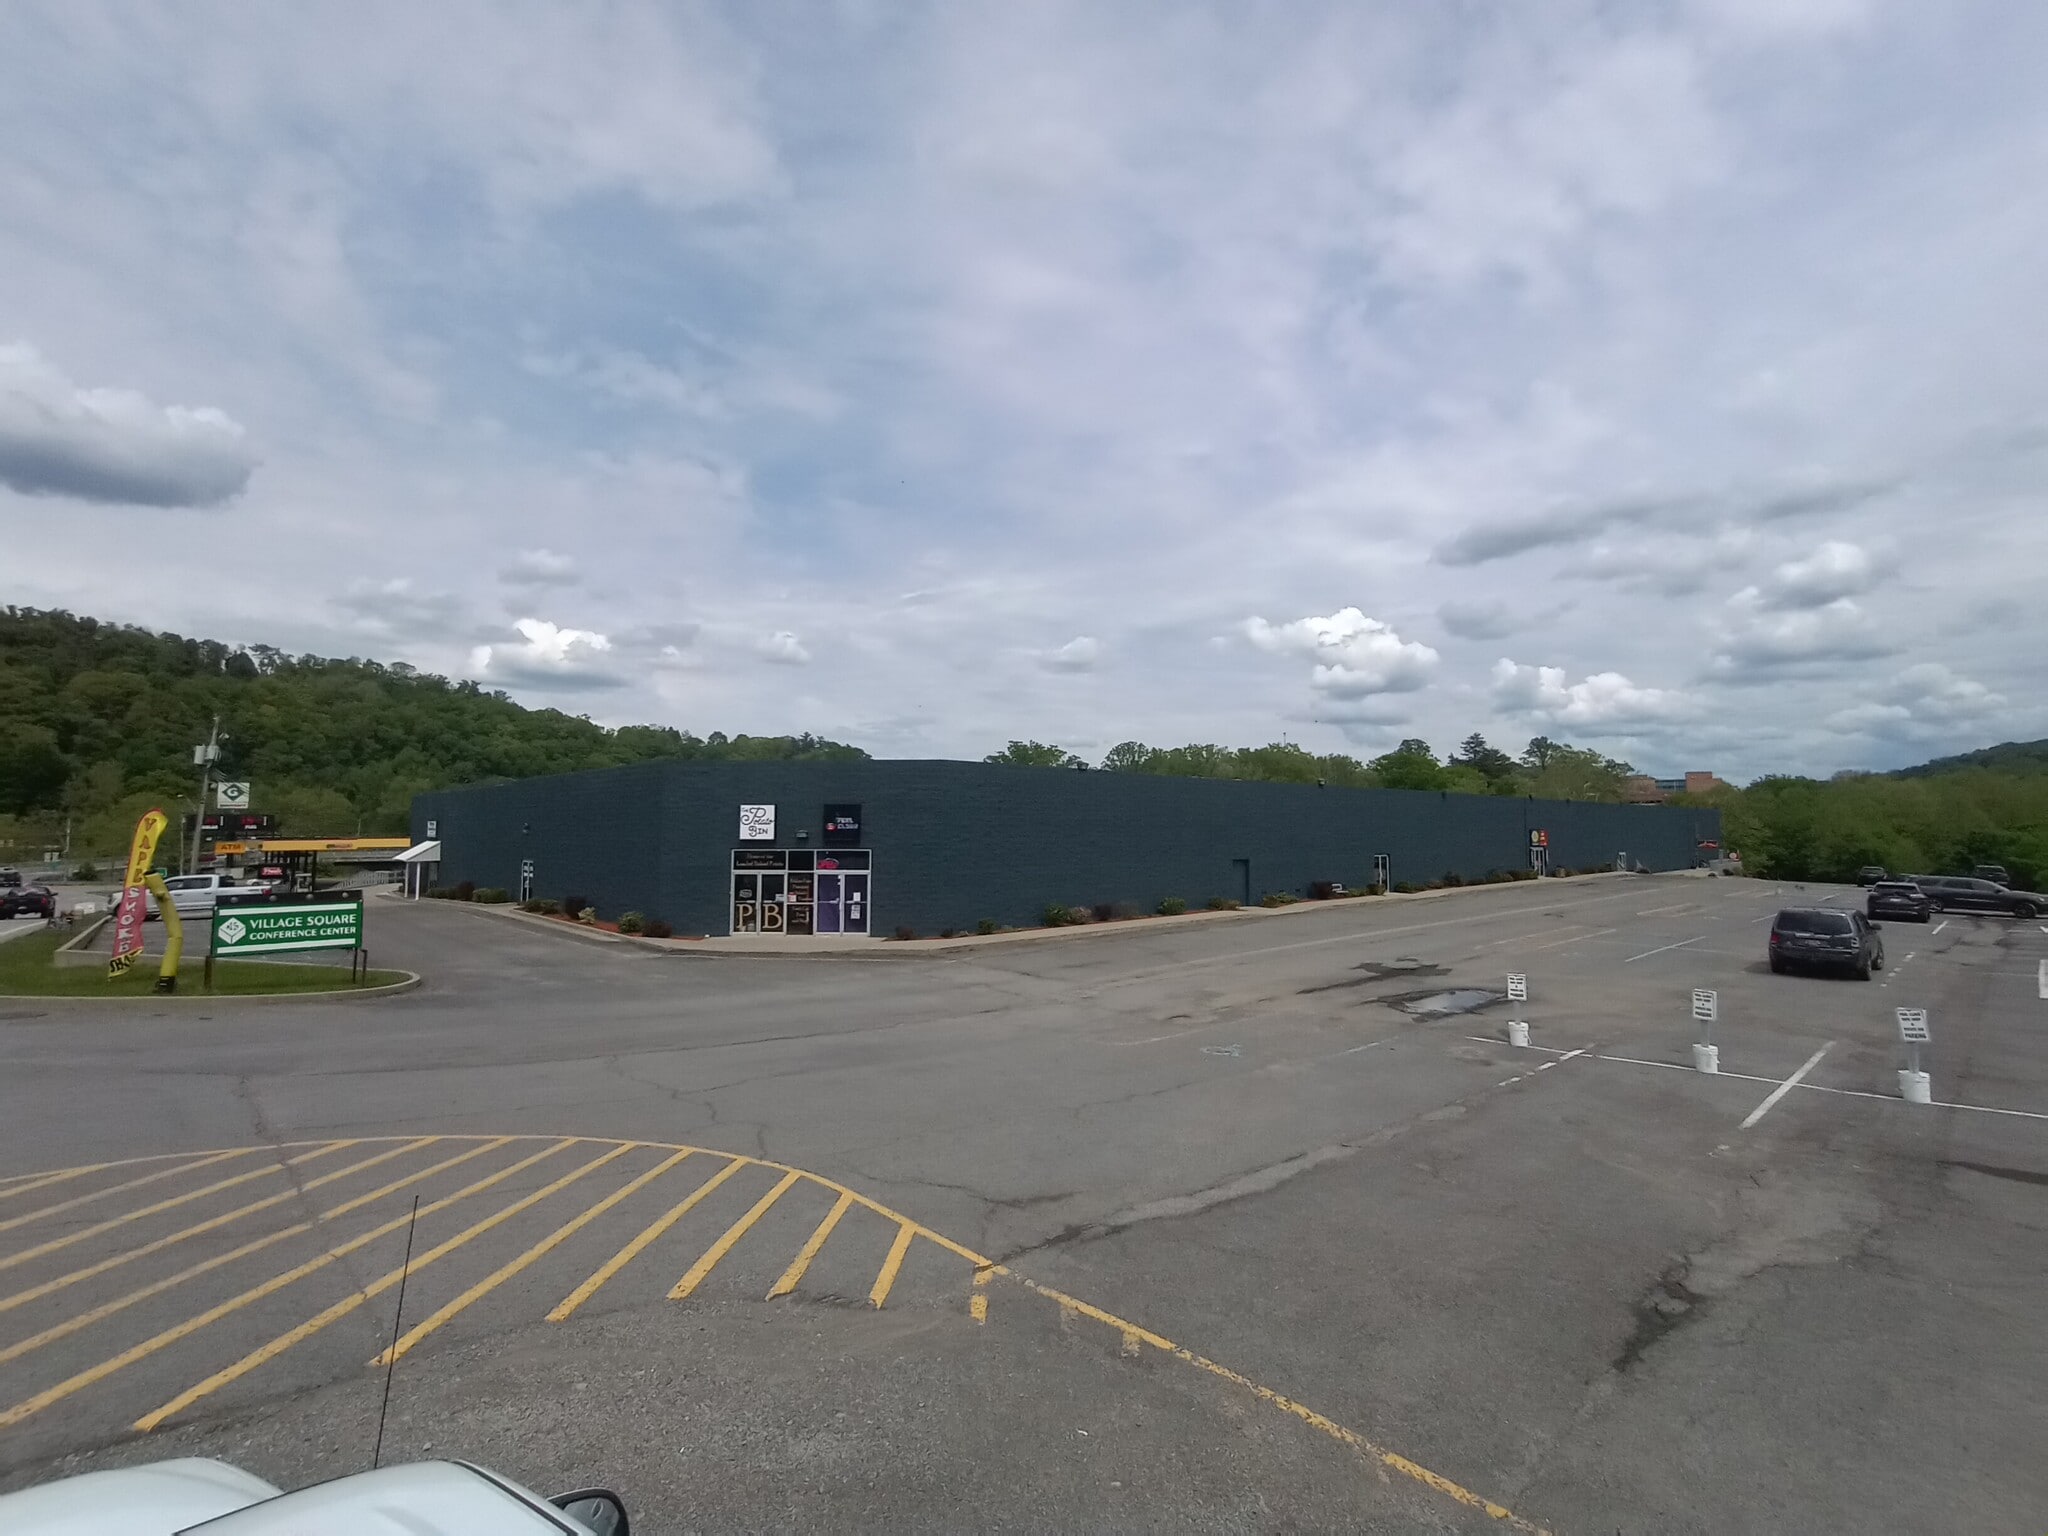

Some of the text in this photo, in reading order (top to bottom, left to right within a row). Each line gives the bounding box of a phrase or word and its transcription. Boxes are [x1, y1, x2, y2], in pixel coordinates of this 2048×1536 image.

[748, 825, 769, 837] BIN
[133, 817, 157, 884] VAPE
[249, 914, 357, 929] VILLAGE SQUARE
[736, 903, 753, 929] P
[762, 903, 782, 929] B
[249, 927, 356, 940] CONFERENCE CENTER
